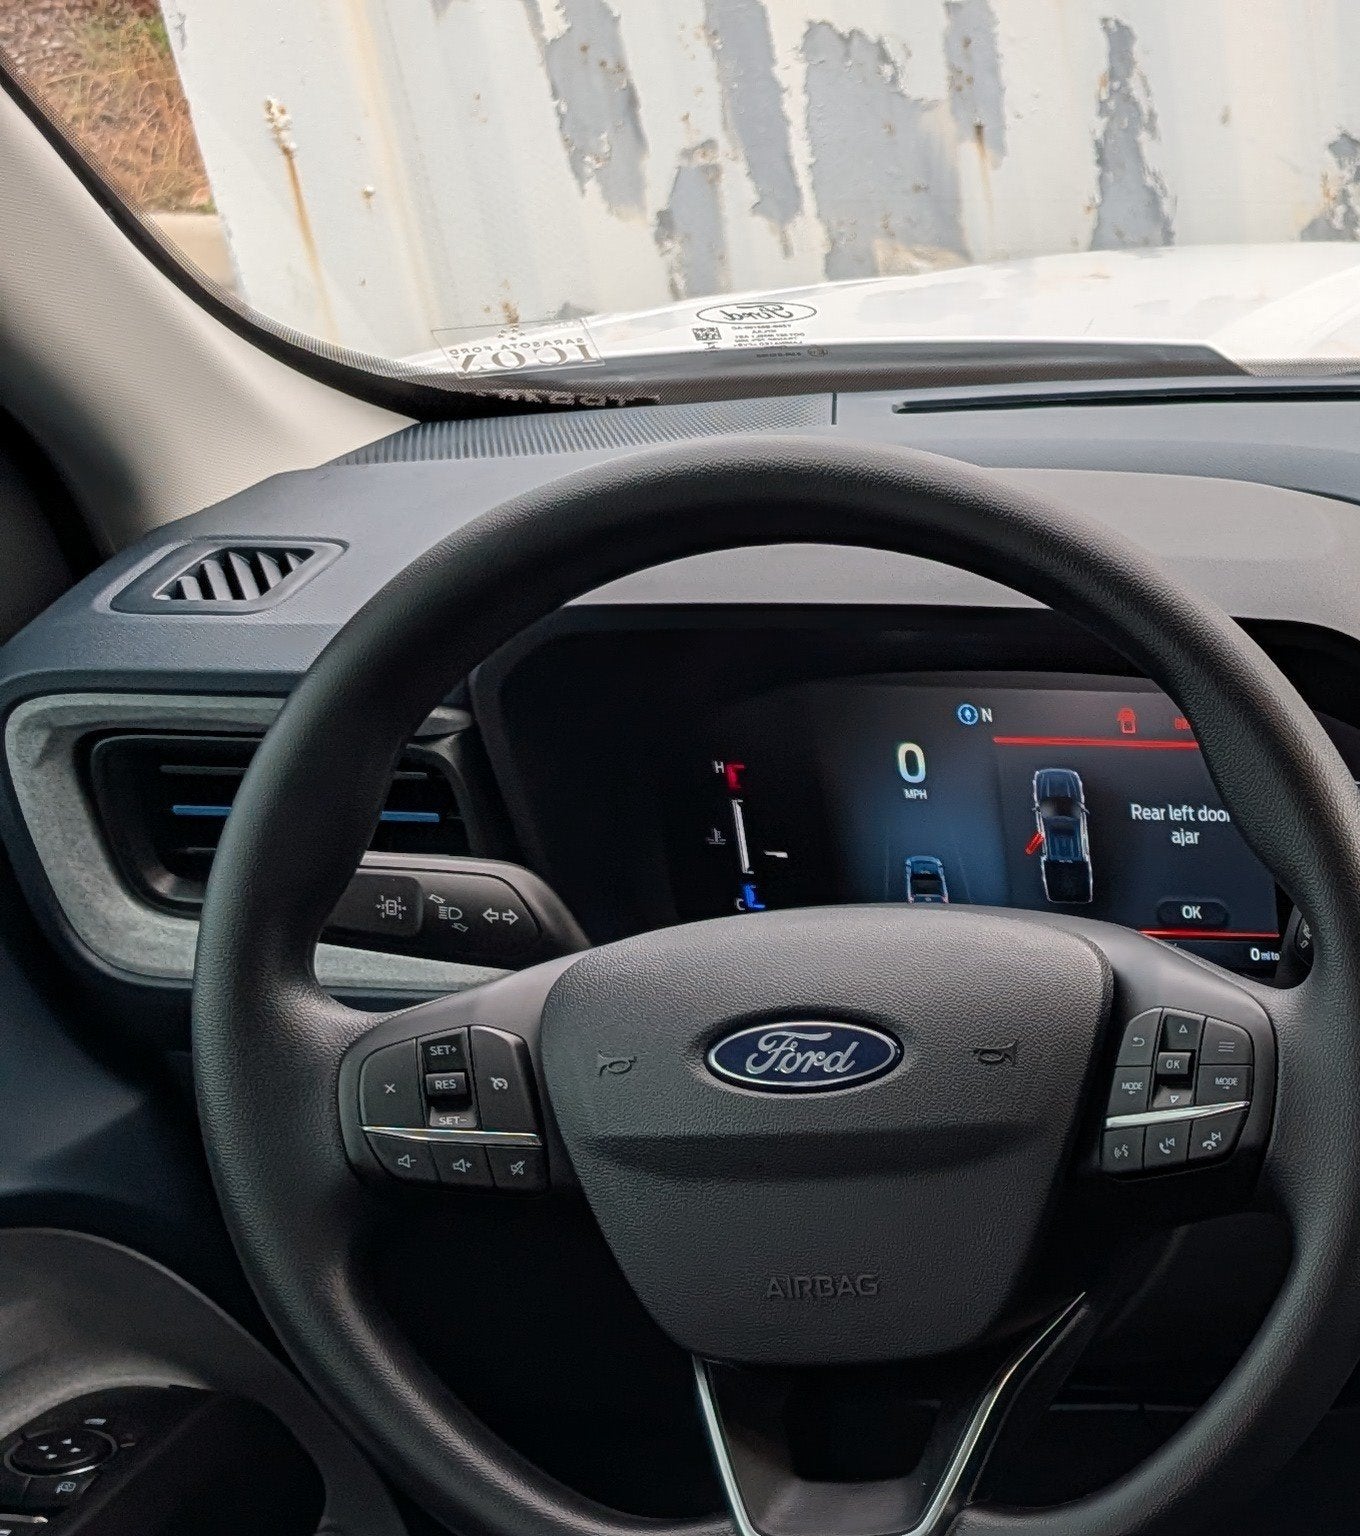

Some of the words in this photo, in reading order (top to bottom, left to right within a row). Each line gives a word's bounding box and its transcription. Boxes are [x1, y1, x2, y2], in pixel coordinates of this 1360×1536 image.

[981, 709, 993, 723] N
[714, 760, 725, 774] H
[897, 740, 928, 784] 0
[902, 788, 928, 802] MPH
[1131, 803, 1166, 822] Rear
[1168, 803, 1195, 822] left
[1171, 828, 1200, 847] ajar
[1181, 905, 1202, 920] OK
[1249, 947, 1260, 961] 0
[746, 1030, 859, 1075] Ford
[1166, 1058, 1181, 1071] OK
[434, 1078, 457, 1091] RES
[1121, 1081, 1143, 1093] MODE
[1214, 1076, 1238, 1089] MODE
[765, 1274, 880, 1299] AIRBAG
